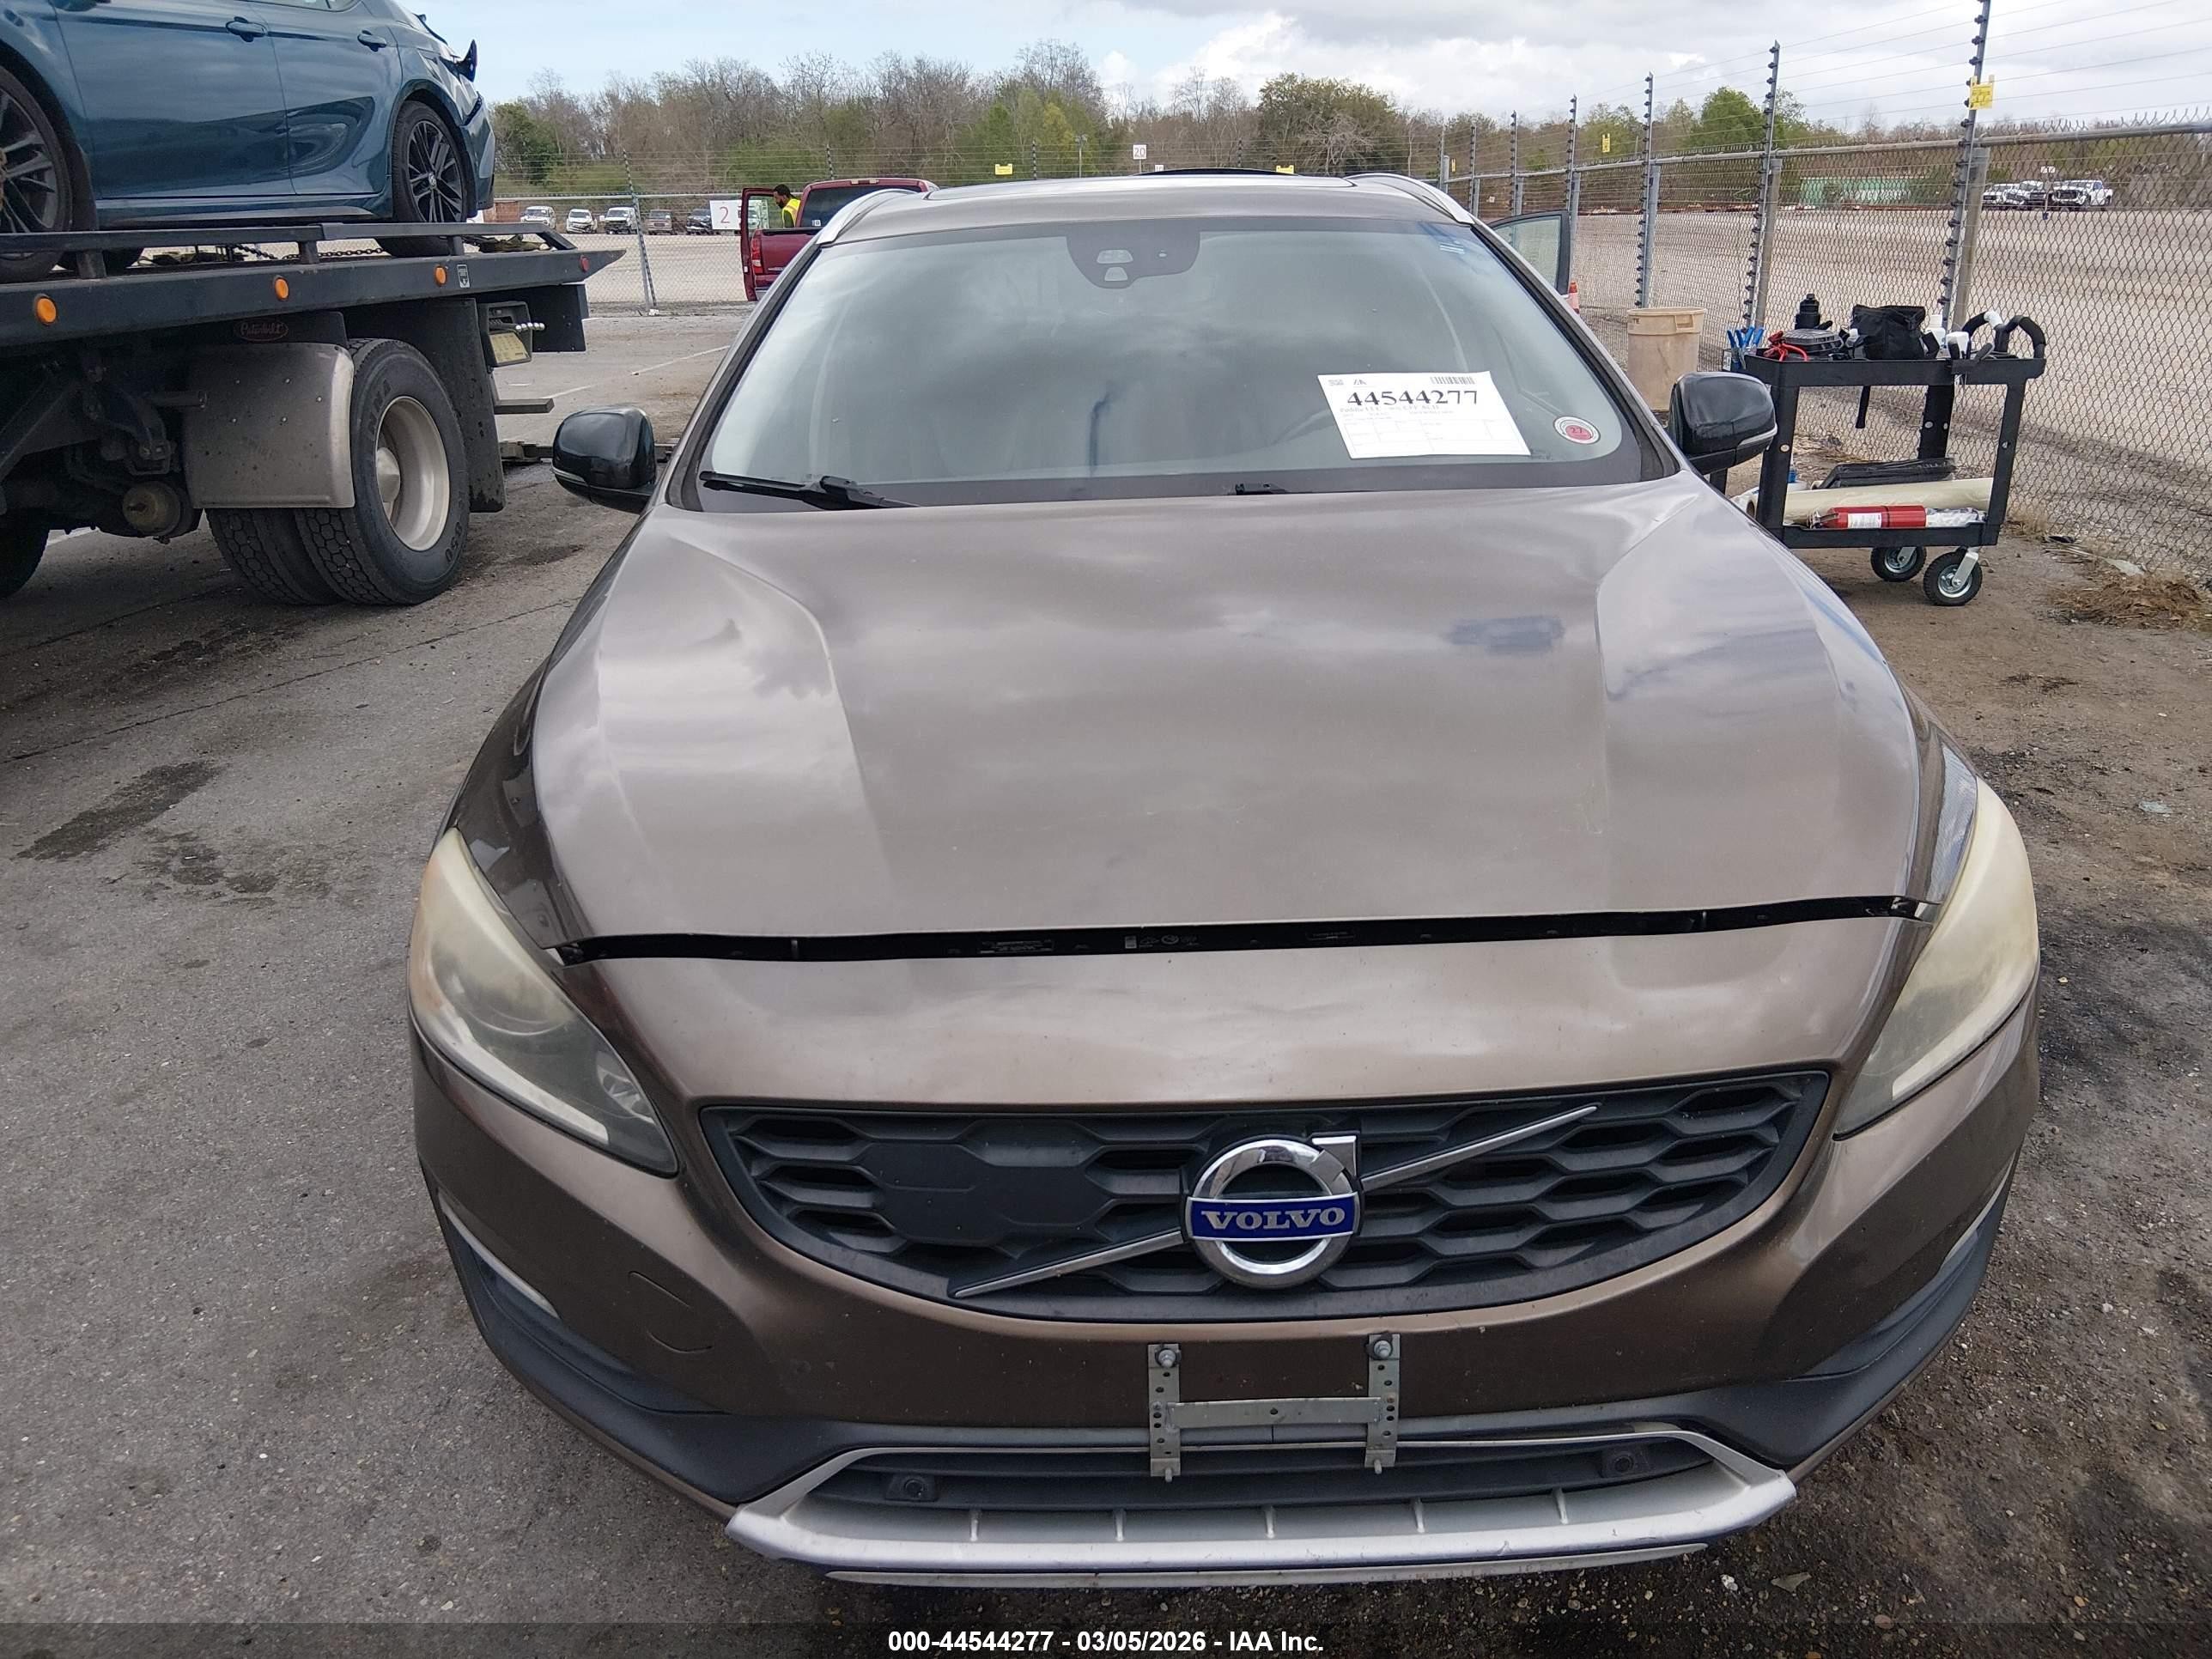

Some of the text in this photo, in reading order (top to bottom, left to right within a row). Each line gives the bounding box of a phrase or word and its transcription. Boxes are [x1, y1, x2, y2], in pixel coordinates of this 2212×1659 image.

[1134, 147, 1146, 158] 20
[720, 206, 731, 224] 2
[1347, 390, 1478, 406] 44544277
[1200, 1206, 1346, 1230] VOLVO
